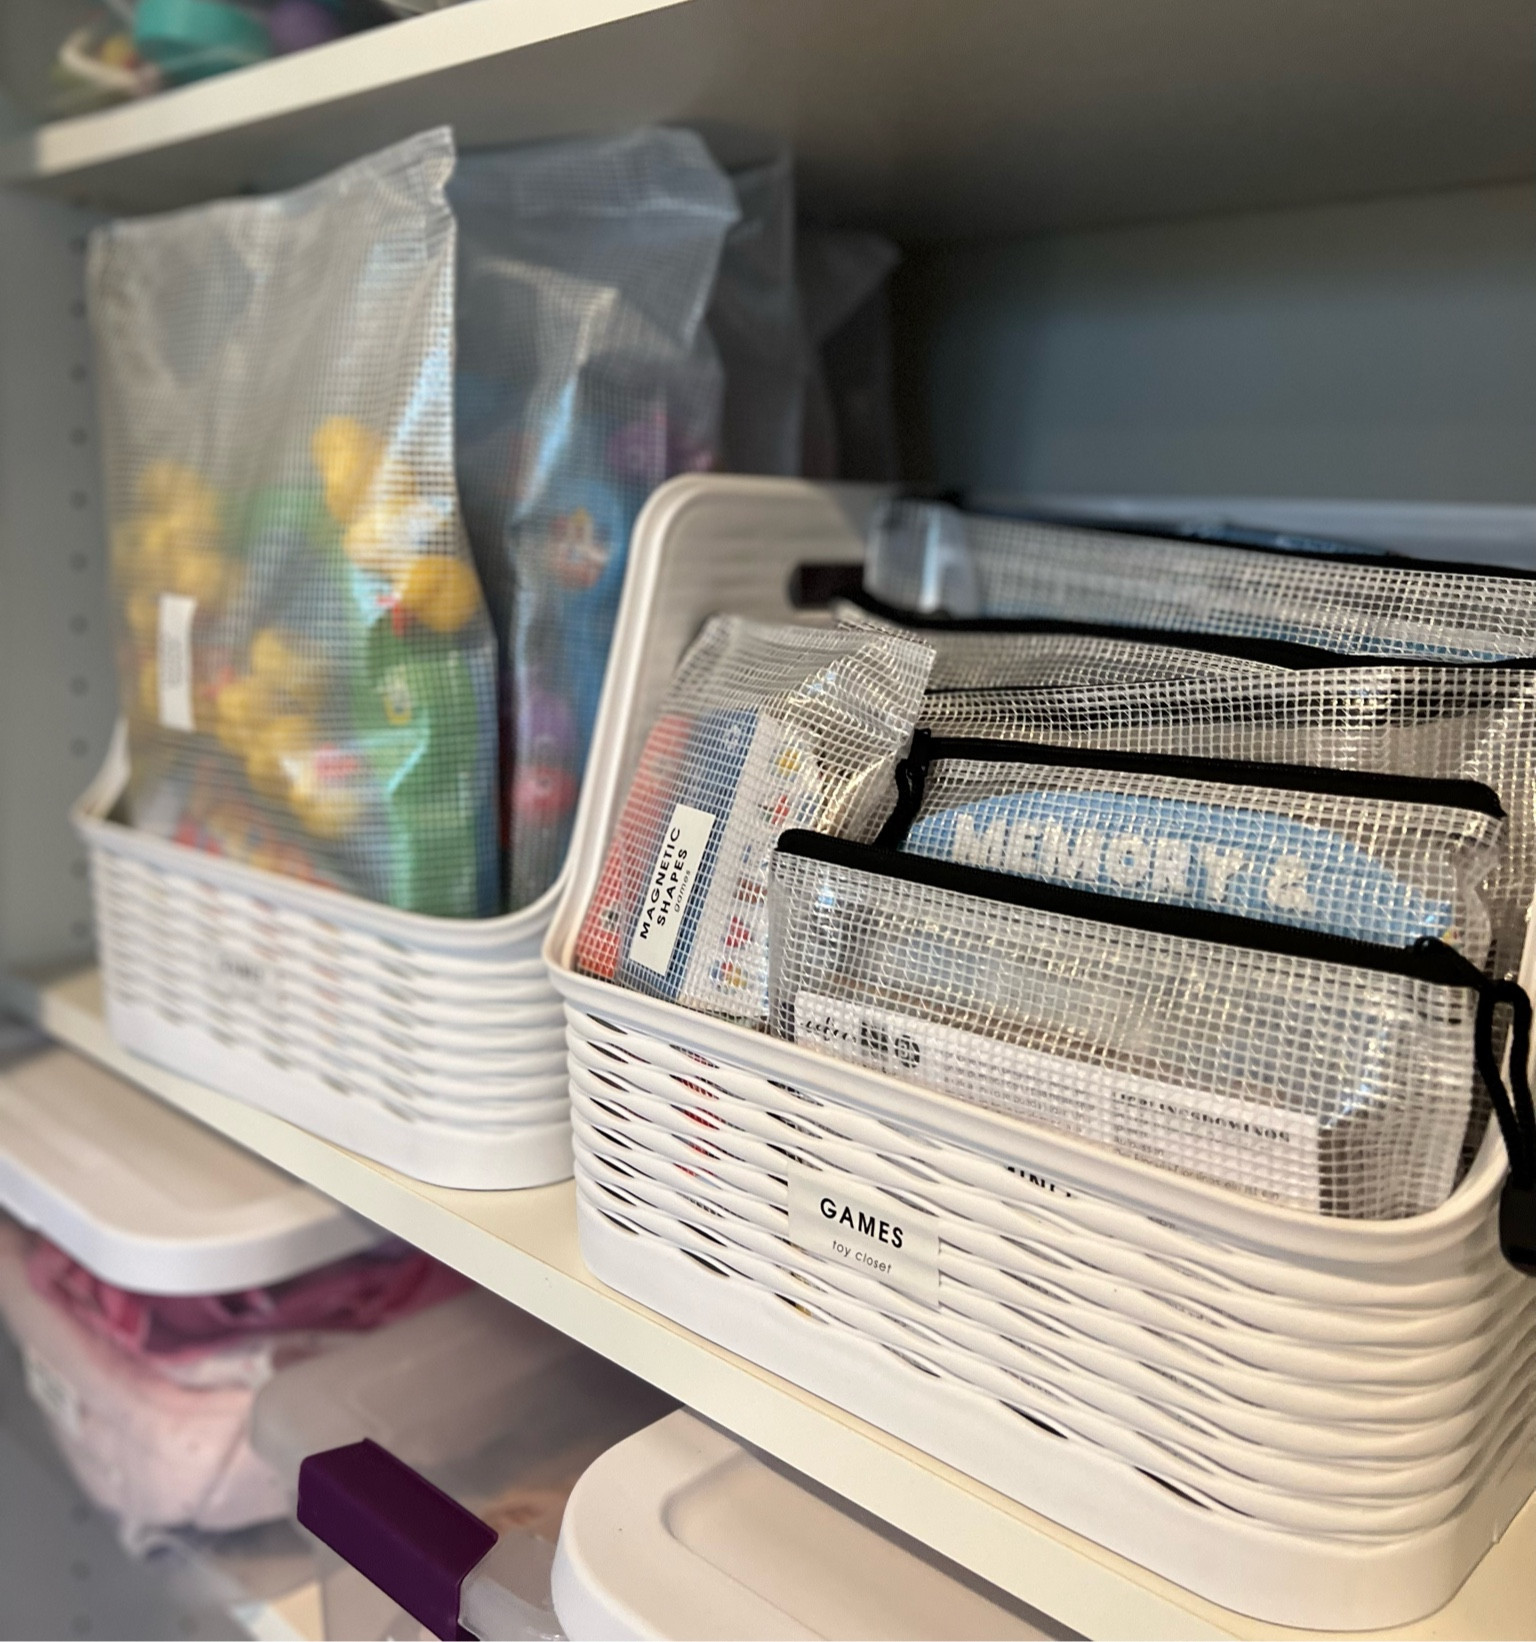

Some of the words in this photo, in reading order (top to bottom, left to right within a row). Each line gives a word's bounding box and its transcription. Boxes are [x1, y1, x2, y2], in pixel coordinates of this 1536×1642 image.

[639, 827, 681, 939] MAGNETIC
[656, 848, 688, 926] SHAPES
[674, 869, 691, 913] games
[951, 812, 1247, 902] MEMORY
[1266, 854, 1309, 910] &
[820, 1197, 904, 1249] GAMES
[832, 1239, 852, 1257] toy
[855, 1250, 893, 1275] closet
